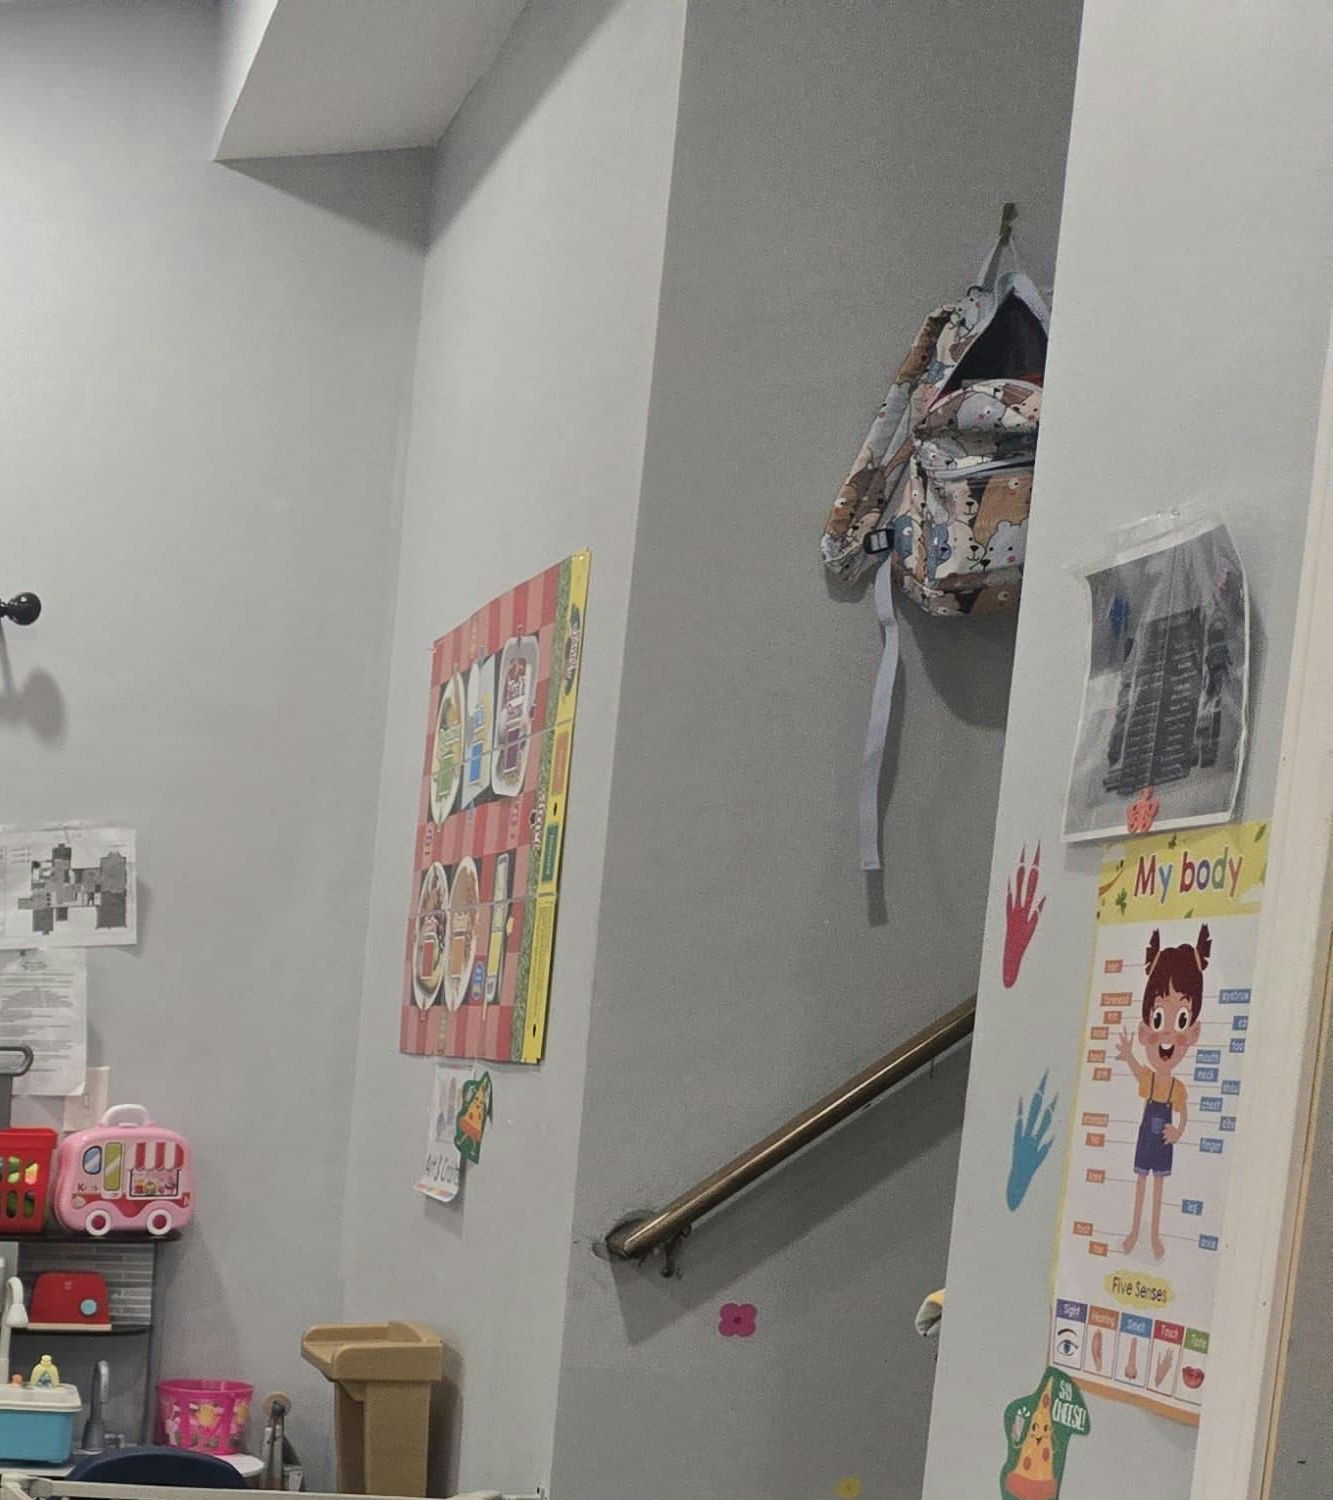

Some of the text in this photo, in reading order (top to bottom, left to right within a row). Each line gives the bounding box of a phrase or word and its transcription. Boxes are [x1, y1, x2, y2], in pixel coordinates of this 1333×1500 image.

[1134, 846, 1243, 904] My body
[1111, 1276, 1168, 1304] Five Senses
[1160, 1324, 1179, 1340] Touch
